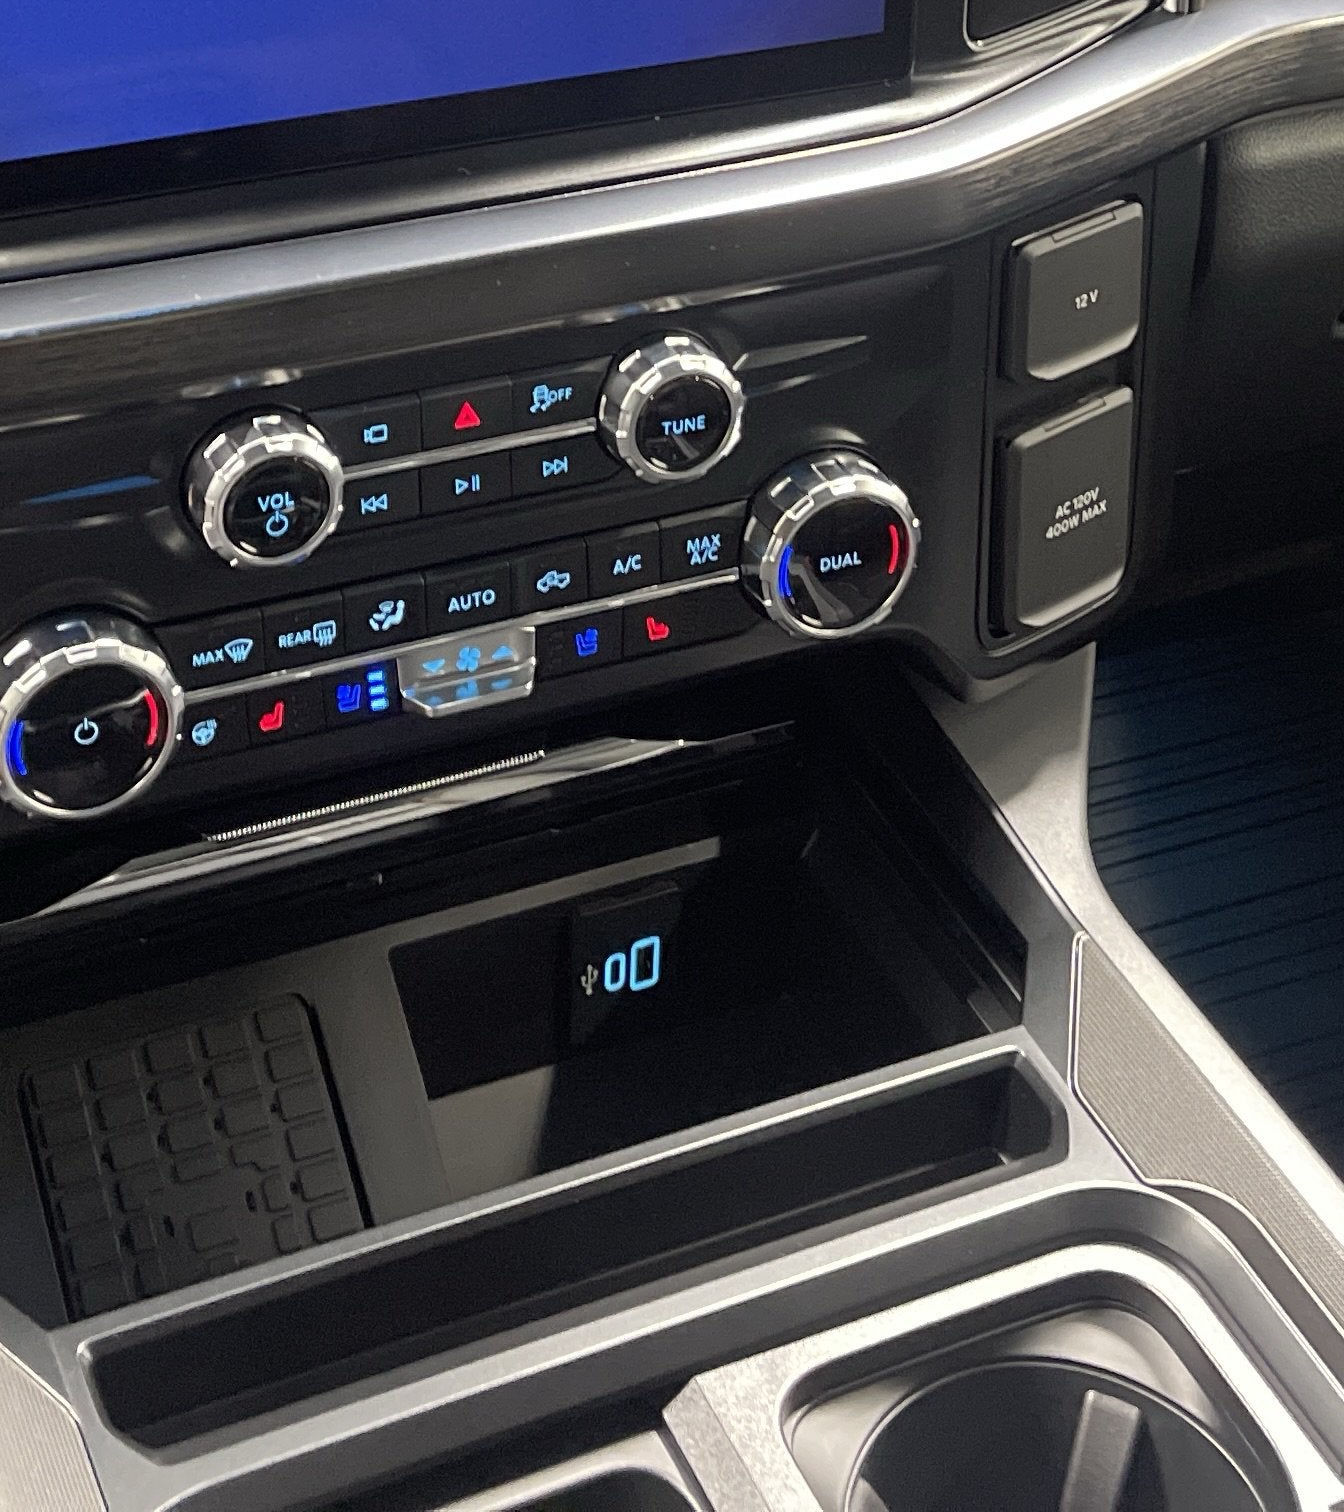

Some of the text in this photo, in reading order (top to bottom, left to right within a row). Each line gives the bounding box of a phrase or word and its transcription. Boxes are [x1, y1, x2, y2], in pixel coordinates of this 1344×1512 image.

[1074, 288, 1099, 310] 12 V
[548, 386, 573, 403] OFF
[661, 414, 706, 436] TUNE
[257, 491, 295, 510] VOL
[1055, 486, 1099, 519] AC 120V
[1045, 499, 1107, 539] 400W MAX
[686, 533, 721, 554] MAX
[612, 554, 642, 576] A/C
[690, 547, 719, 566] A/C
[819, 551, 862, 573] DUAL
[447, 588, 496, 613] AUTO
[278, 629, 312, 649] REAR
[192, 647, 225, 667] MAX
